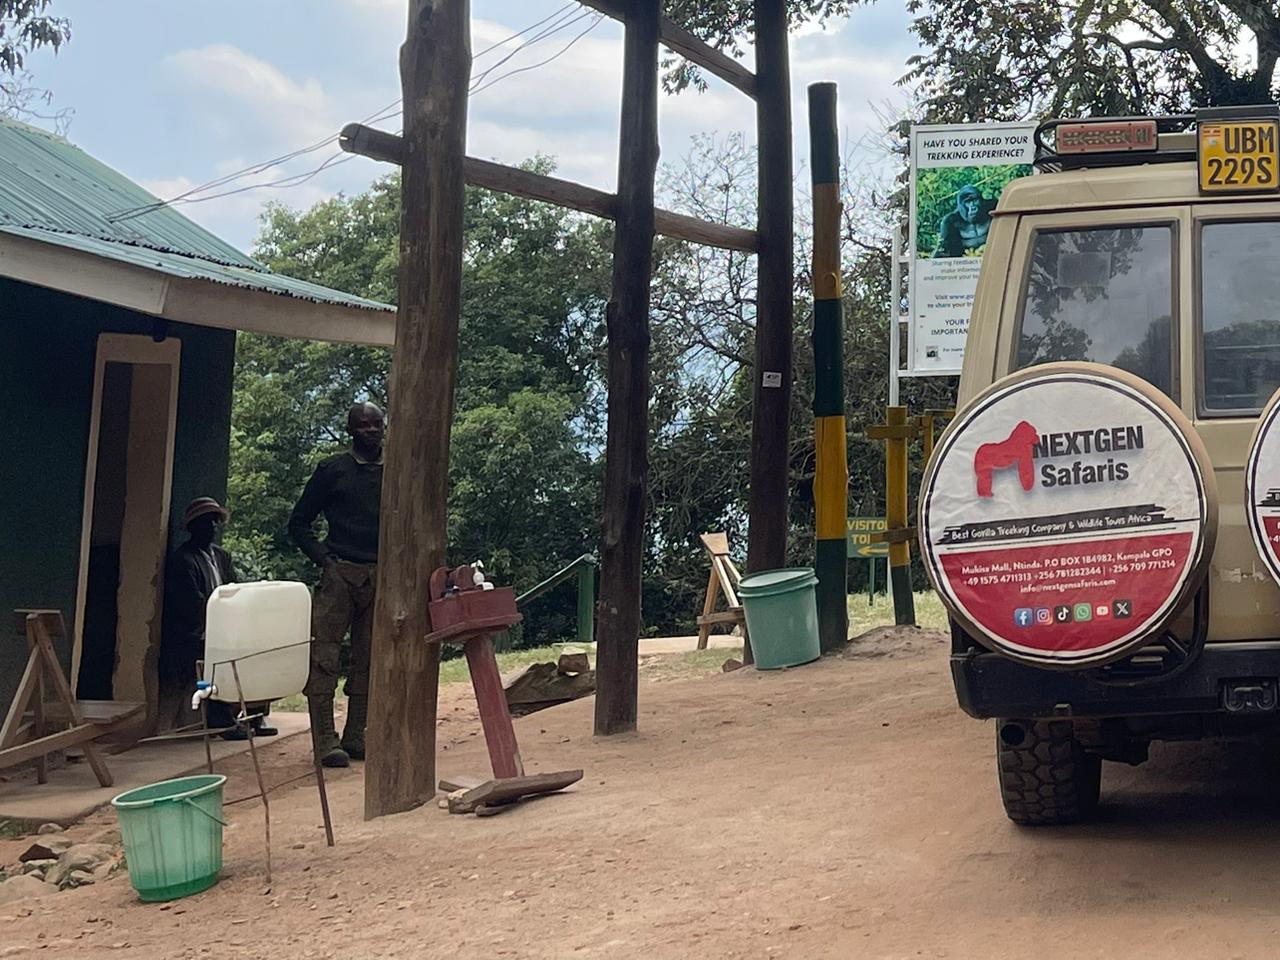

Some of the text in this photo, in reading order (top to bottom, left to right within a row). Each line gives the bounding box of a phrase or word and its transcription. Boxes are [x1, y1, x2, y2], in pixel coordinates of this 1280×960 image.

[923, 135, 1029, 149] HAVE YOU SHARED YOUR
[1224, 127, 1275, 154] UBM
[927, 147, 1025, 161] TREKKING EXPERIENCE?
[1207, 156, 1272, 185] 229S
[931, 328, 968, 336] IMPORTAN
[1032, 425, 1144, 458] NEXTGEN
[1040, 459, 1129, 488] Safaris
[951, 530, 969, 540] Best
[971, 527, 996, 538] Gorilla
[1031, 522, 1067, 533] Company
[1076, 518, 1103, 529] Wildlife
[1104, 516, 1126, 526] Tours
[1127, 514, 1152, 524] Africa
[961, 565, 990, 575] Mukisa
[1044, 558, 1059, 567] P.O
[1061, 556, 1081, 566] BOX
[1116, 550, 1151, 562] Kampala
[1152, 548, 1173, 557] GPO
[980, 575, 999, 585] 1575
[1000, 572, 1032, 583] 4711313
[1033, 570, 1055, 579] +256
[1108, 564, 1129, 574] +256
[1130, 562, 1147, 571] 709
[1147, 560, 1176, 570] 771214
[1020, 578, 1117, 594] info@nextgensafaris.com
